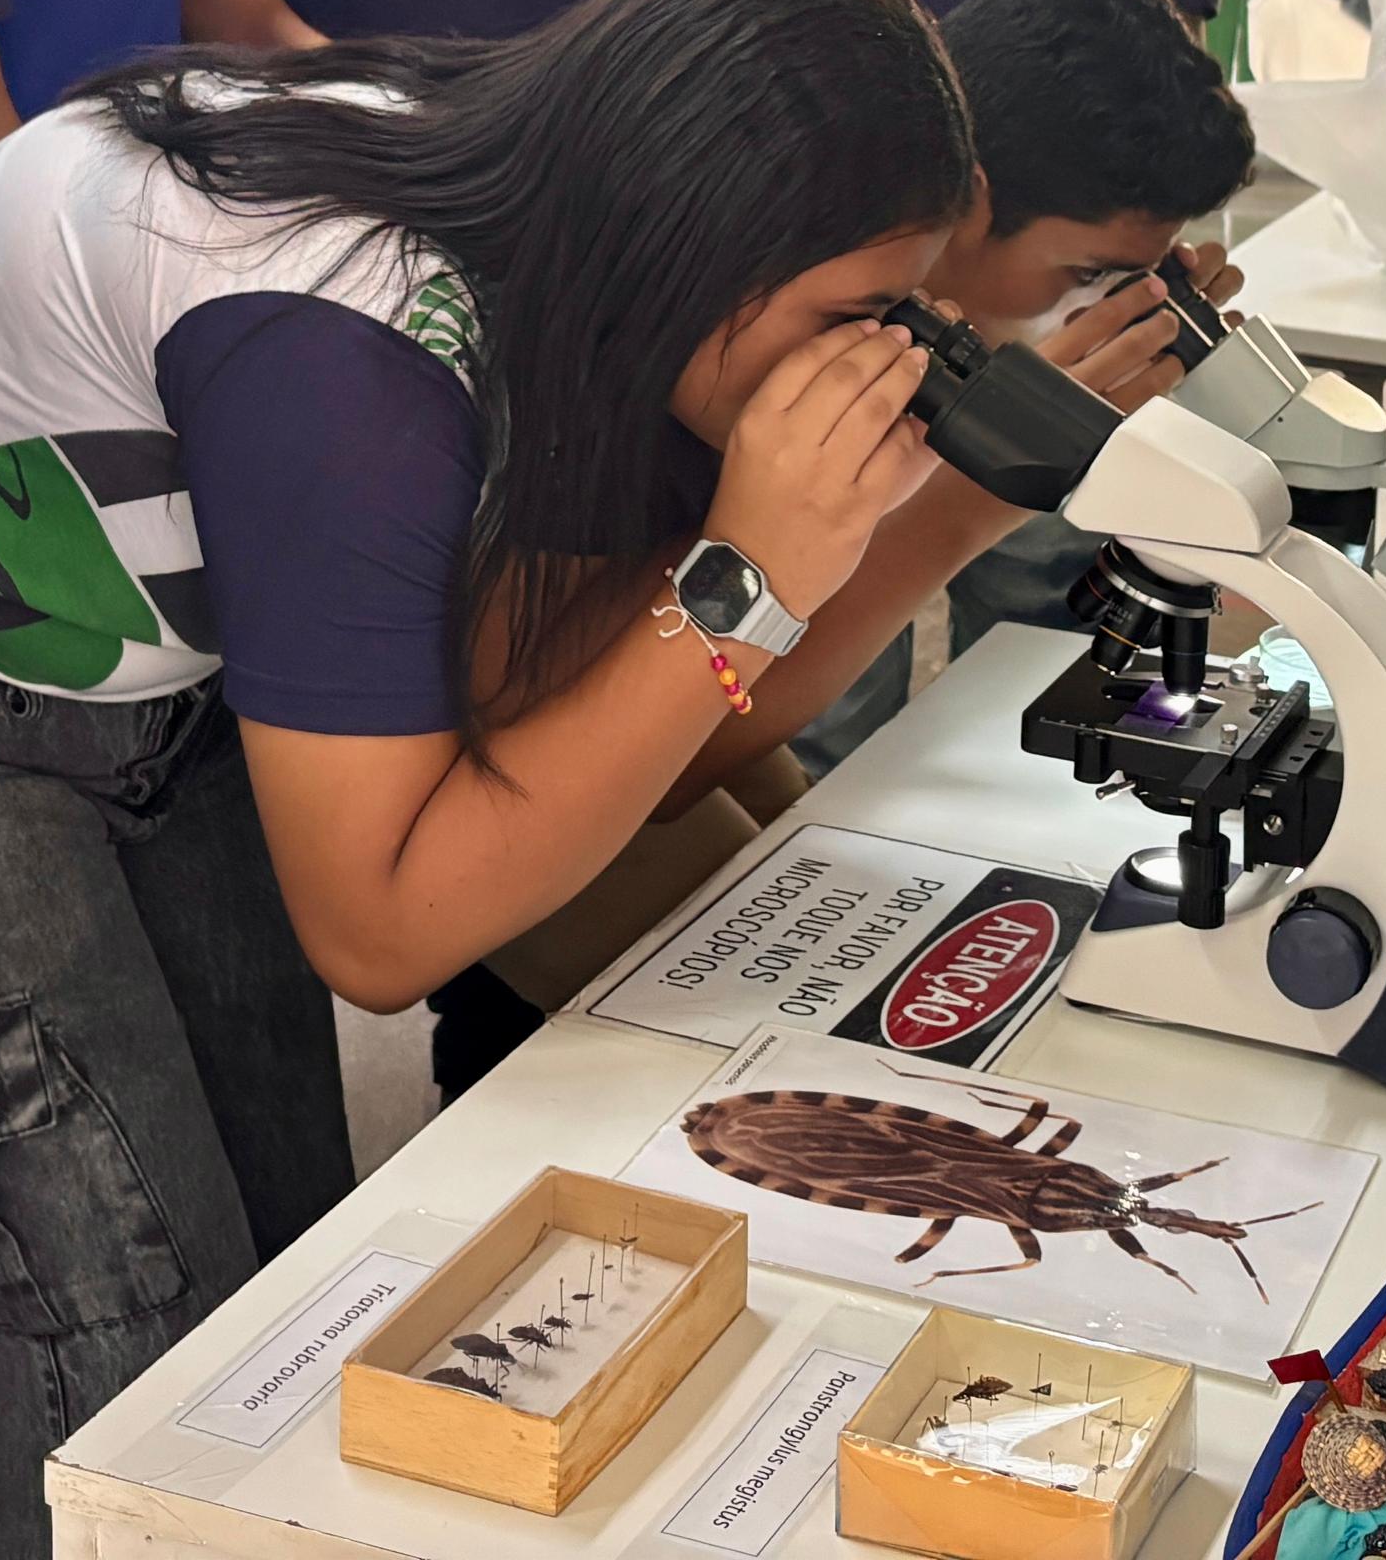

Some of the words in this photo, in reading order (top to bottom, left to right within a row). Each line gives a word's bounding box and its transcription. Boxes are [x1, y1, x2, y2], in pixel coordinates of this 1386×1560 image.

[658, 857, 832, 991] MICROSCÓPIOS!
[782, 888, 868, 945] TOQUE
[883, 876, 946, 914] POR
[740, 943, 807, 984] NOS
[902, 915, 1040, 1028] ATENÇÃO
[778, 976, 844, 1017] NÃO
[321, 1283, 397, 1340] Triatoma
[241, 1339, 328, 1412] rubrovaria
[767, 1370, 857, 1466] Panstrongylus
[713, 1464, 776, 1529] megistus
